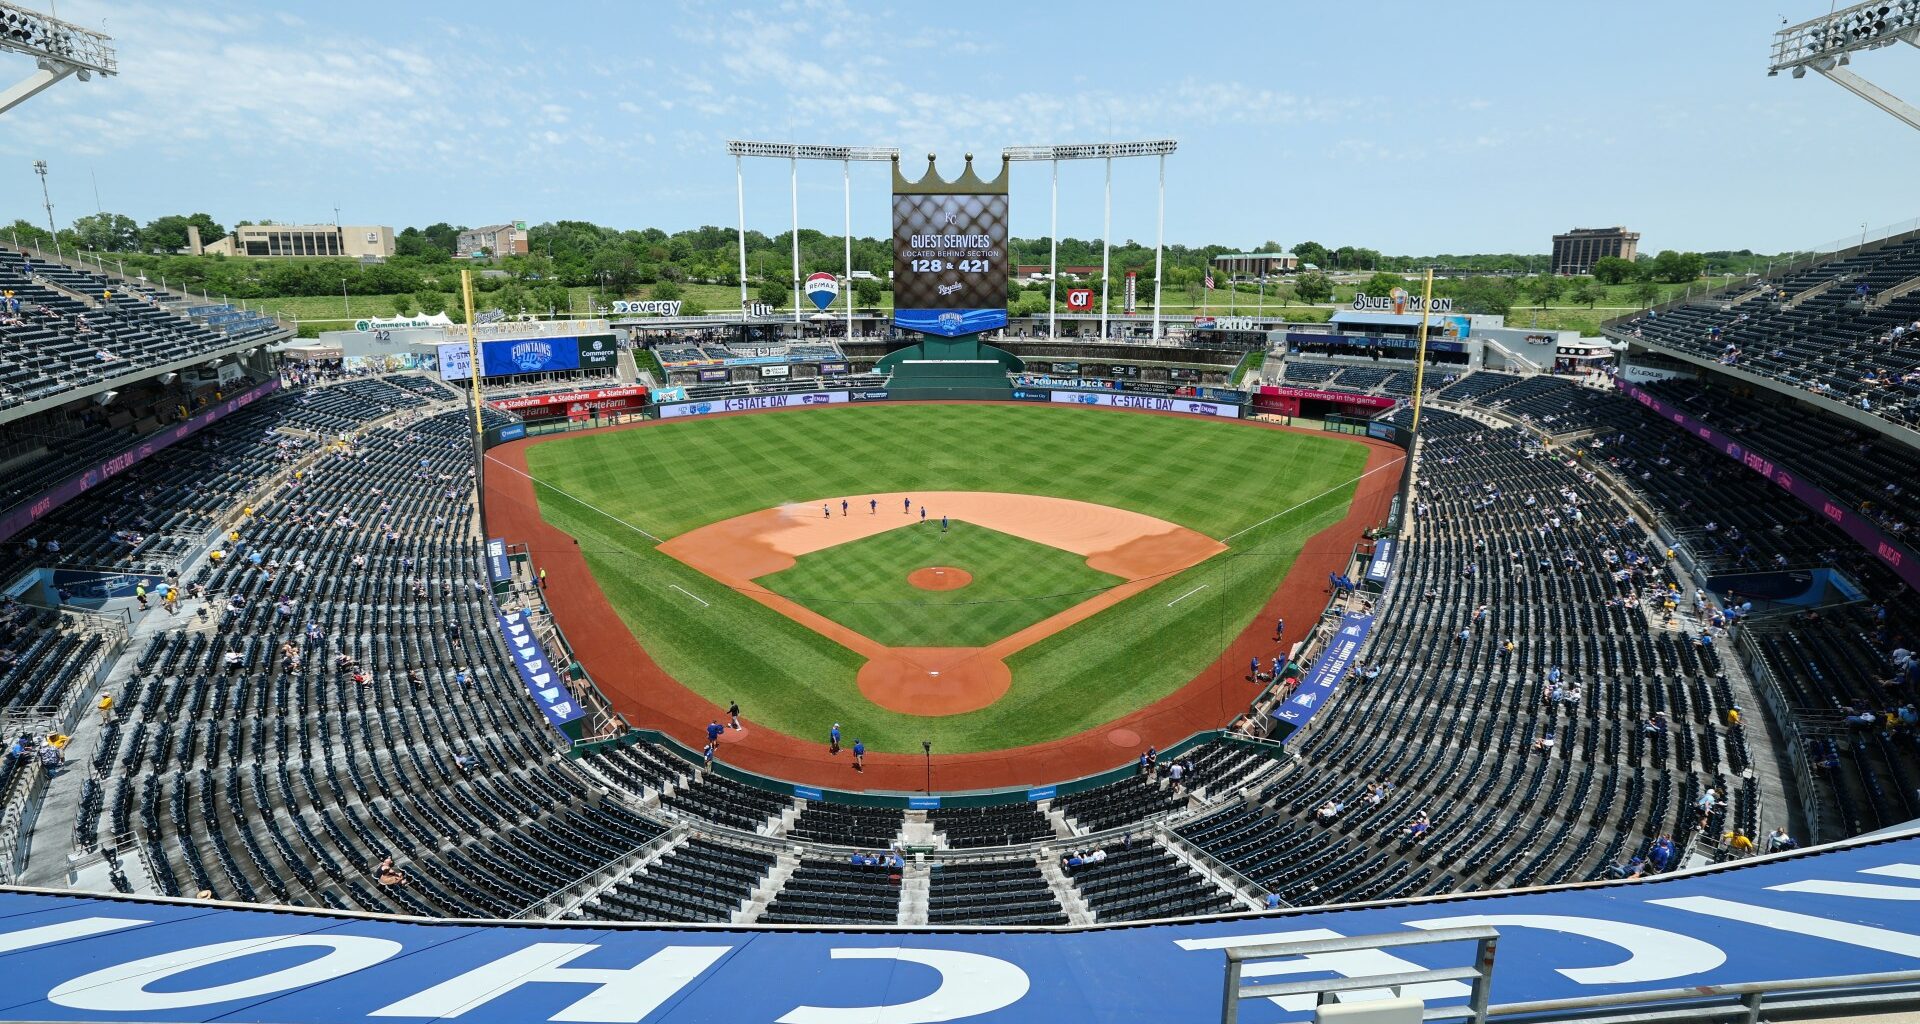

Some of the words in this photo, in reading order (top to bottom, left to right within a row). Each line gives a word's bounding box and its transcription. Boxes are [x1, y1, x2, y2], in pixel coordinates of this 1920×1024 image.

[911, 235, 943, 248] GUEST
[944, 234, 990, 248] SERVICES
[911, 259, 942, 273] 128
[946, 262, 954, 270] &
[958, 259, 989, 273] 421
[1069, 290, 1089, 307] QT
[1353, 293, 1390, 310] BLUE
[631, 301, 681, 316] evergy
[750, 303, 774, 318] Lite
[1216, 317, 1253, 331] PATIO
[375, 331, 390, 341] 42
[1377, 338, 1407, 348] K-STATE
[512, 341, 552, 359] FOUNTAINS
[581, 350, 614, 358] Commerce
[457, 362, 471, 370] DAY
[1033, 378, 1078, 387] FOUNTAIN
[1080, 380, 1103, 388] DECK
[725, 396, 767, 411] K-STATE
[770, 394, 788, 408] DAY
[1111, 395, 1152, 409] K-STATE
[1156, 398, 1174, 411] DAY
[1295, 389, 1303, 397] 5G
[1305, 391, 1335, 400] coverage
[1356, 397, 1377, 405] game
[1878, 541, 1902, 567] WILDCATS
